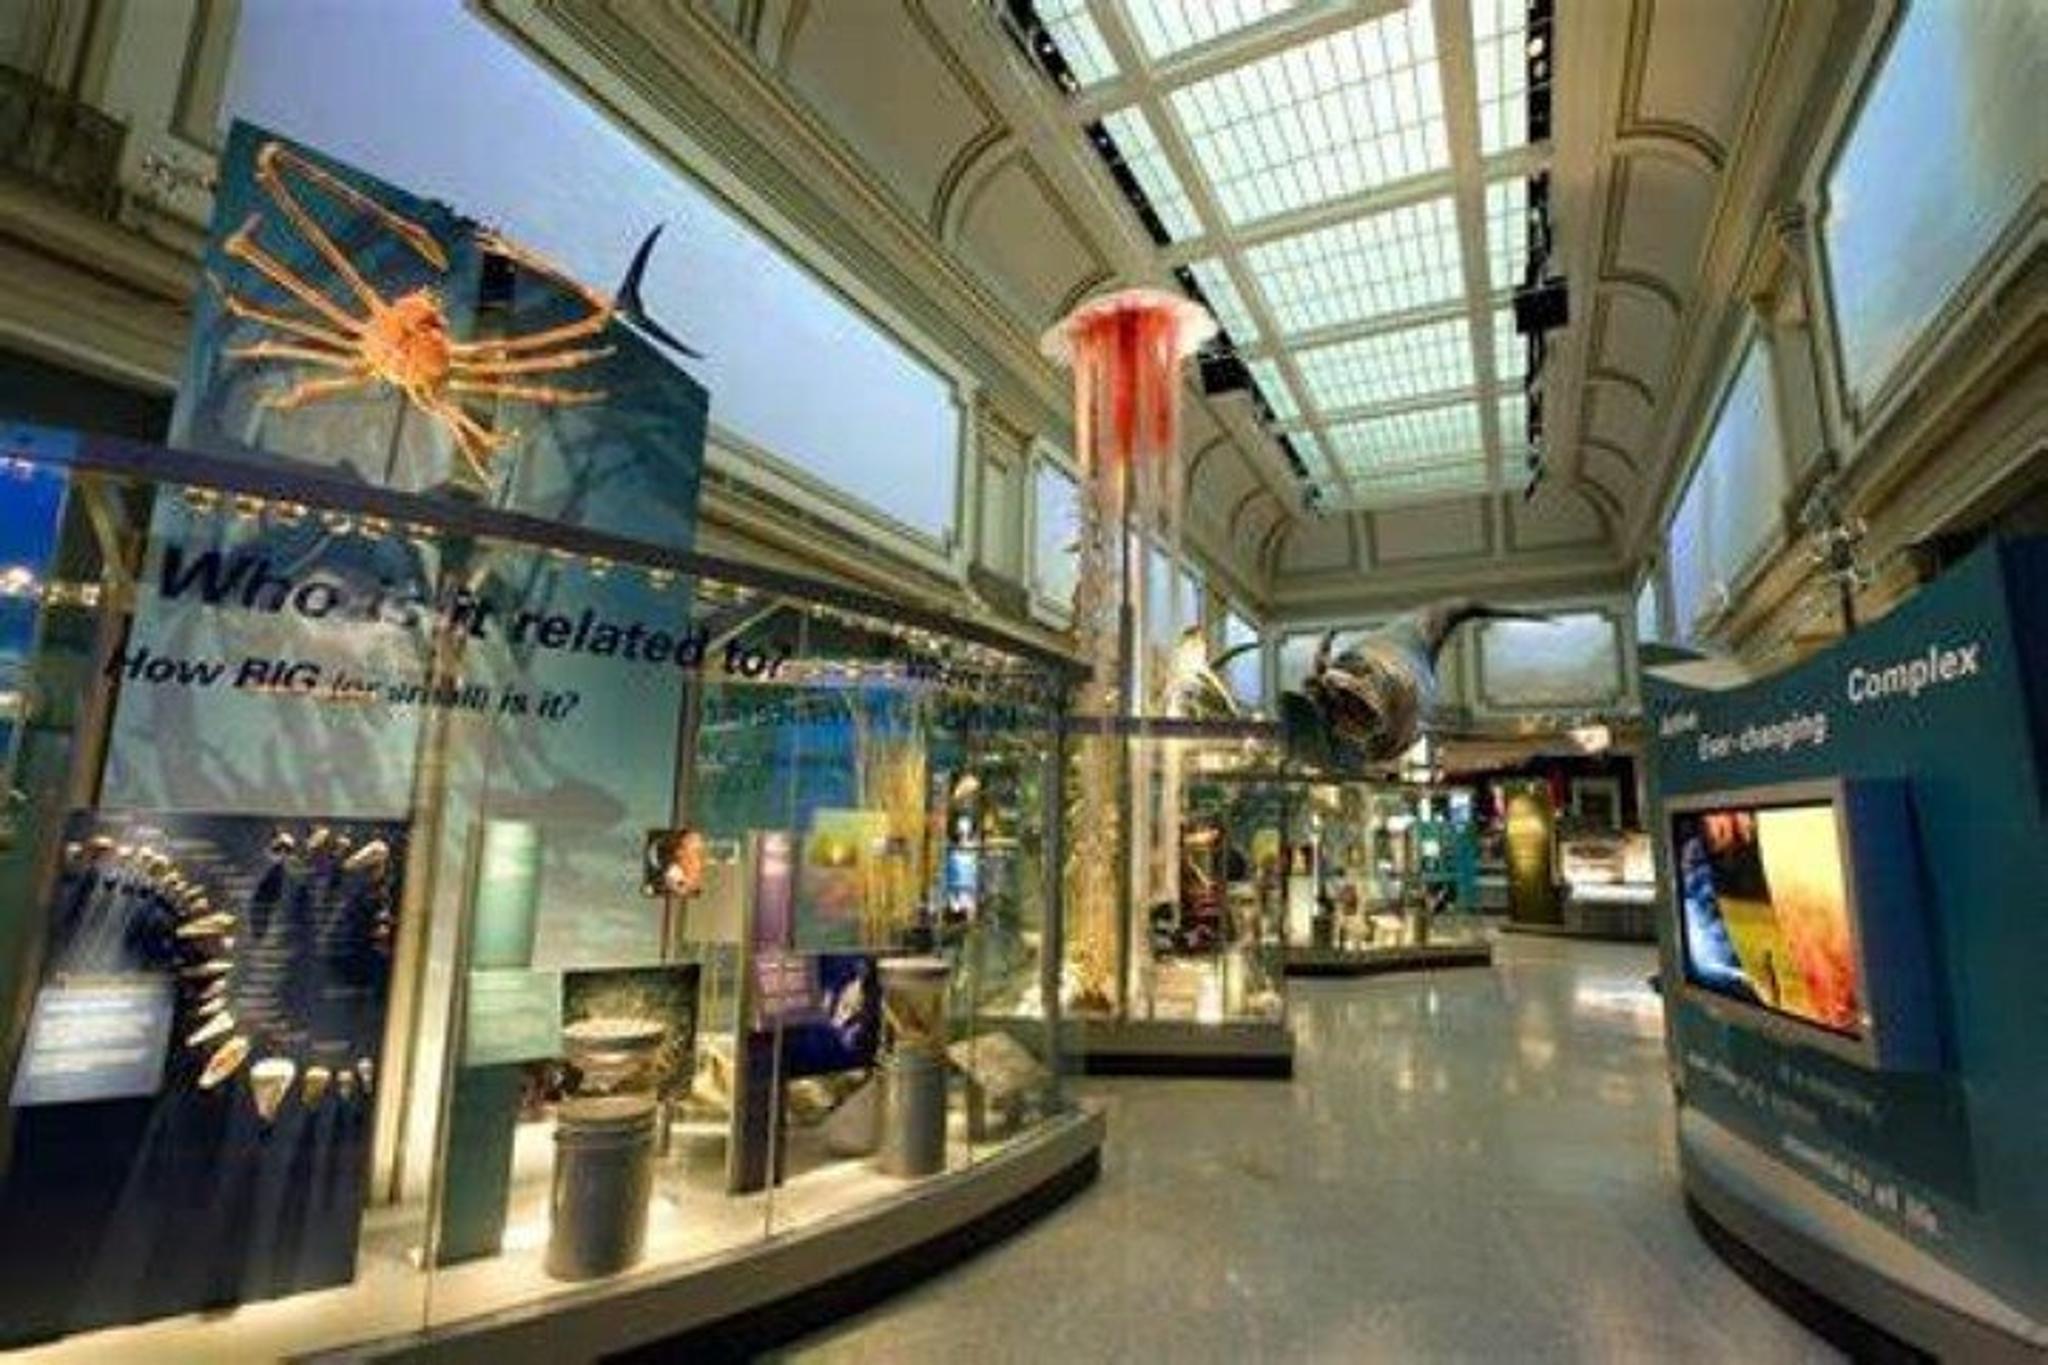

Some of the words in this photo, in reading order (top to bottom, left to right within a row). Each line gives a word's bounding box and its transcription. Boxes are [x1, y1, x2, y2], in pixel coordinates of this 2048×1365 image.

[157, 545, 338, 618] Who
[508, 607, 709, 669] related
[101, 646, 226, 687] How
[538, 690, 580, 719] it?
[1846, 642, 1982, 702] Complex
